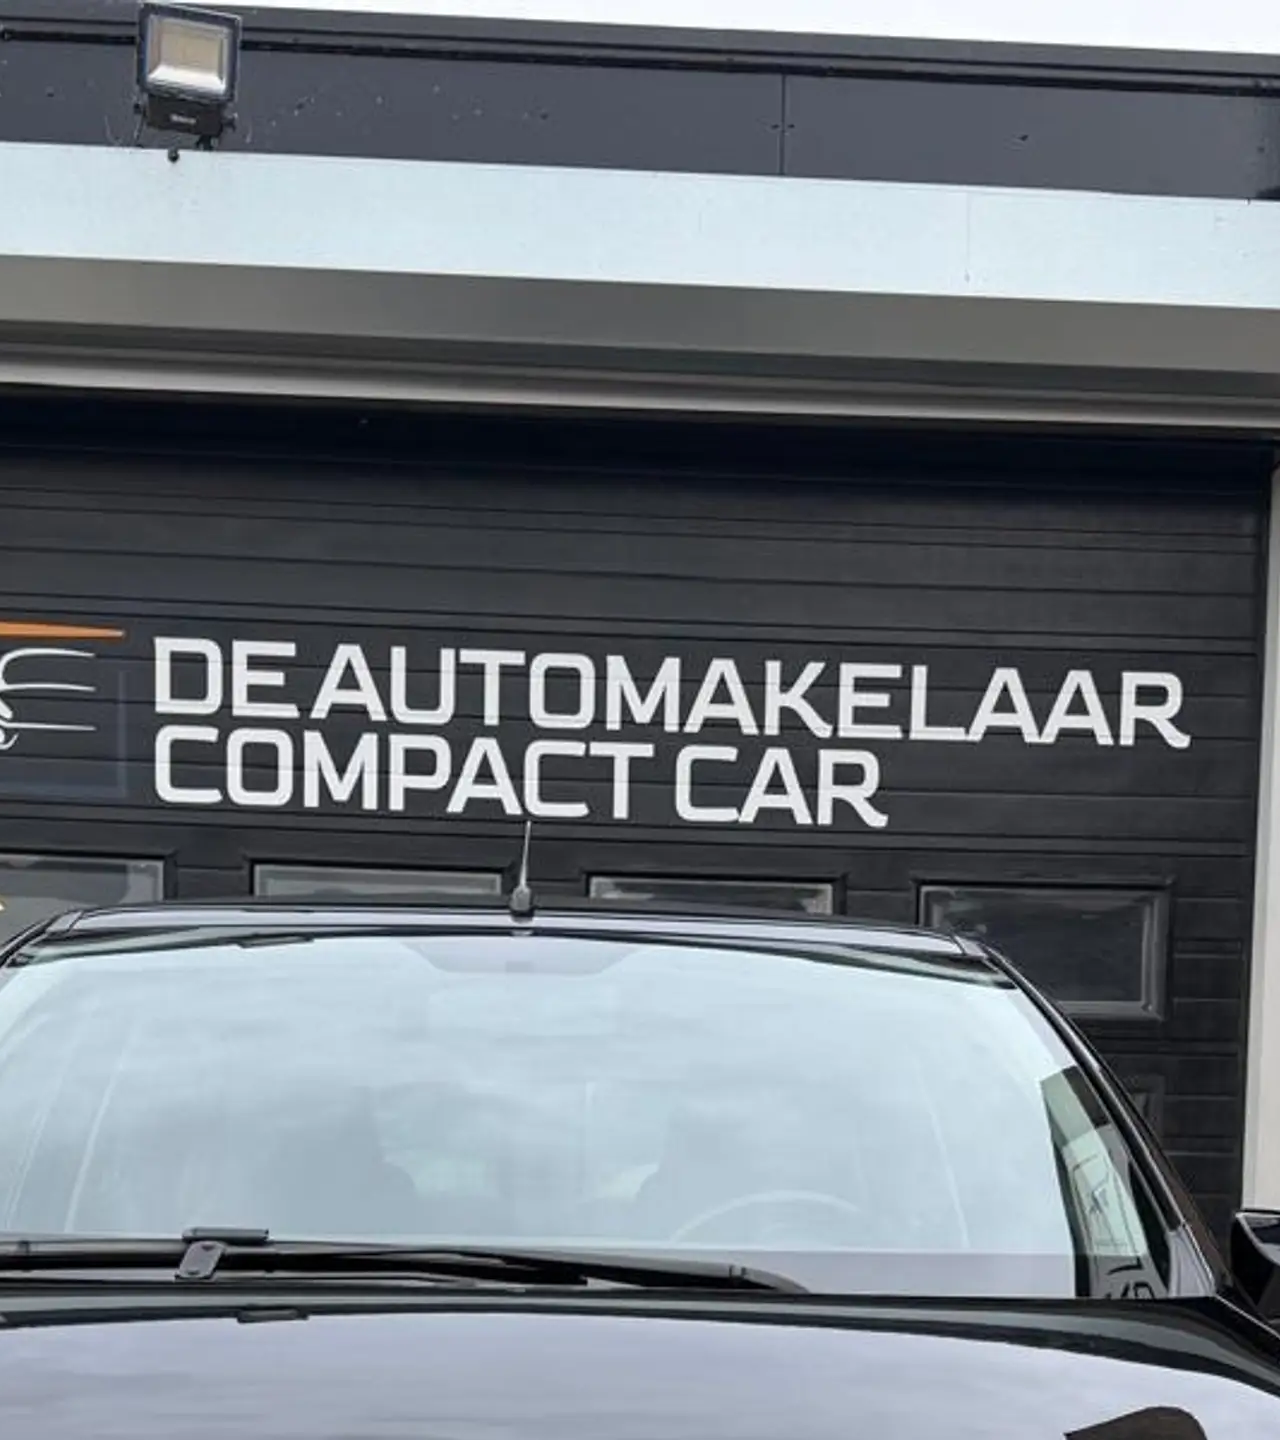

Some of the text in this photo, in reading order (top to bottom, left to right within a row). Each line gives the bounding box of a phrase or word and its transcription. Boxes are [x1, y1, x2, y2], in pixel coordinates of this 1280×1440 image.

[154, 635, 1190, 750] DE AUTOMAKELAAR
[154, 724, 888, 830] COMPACT CAR
